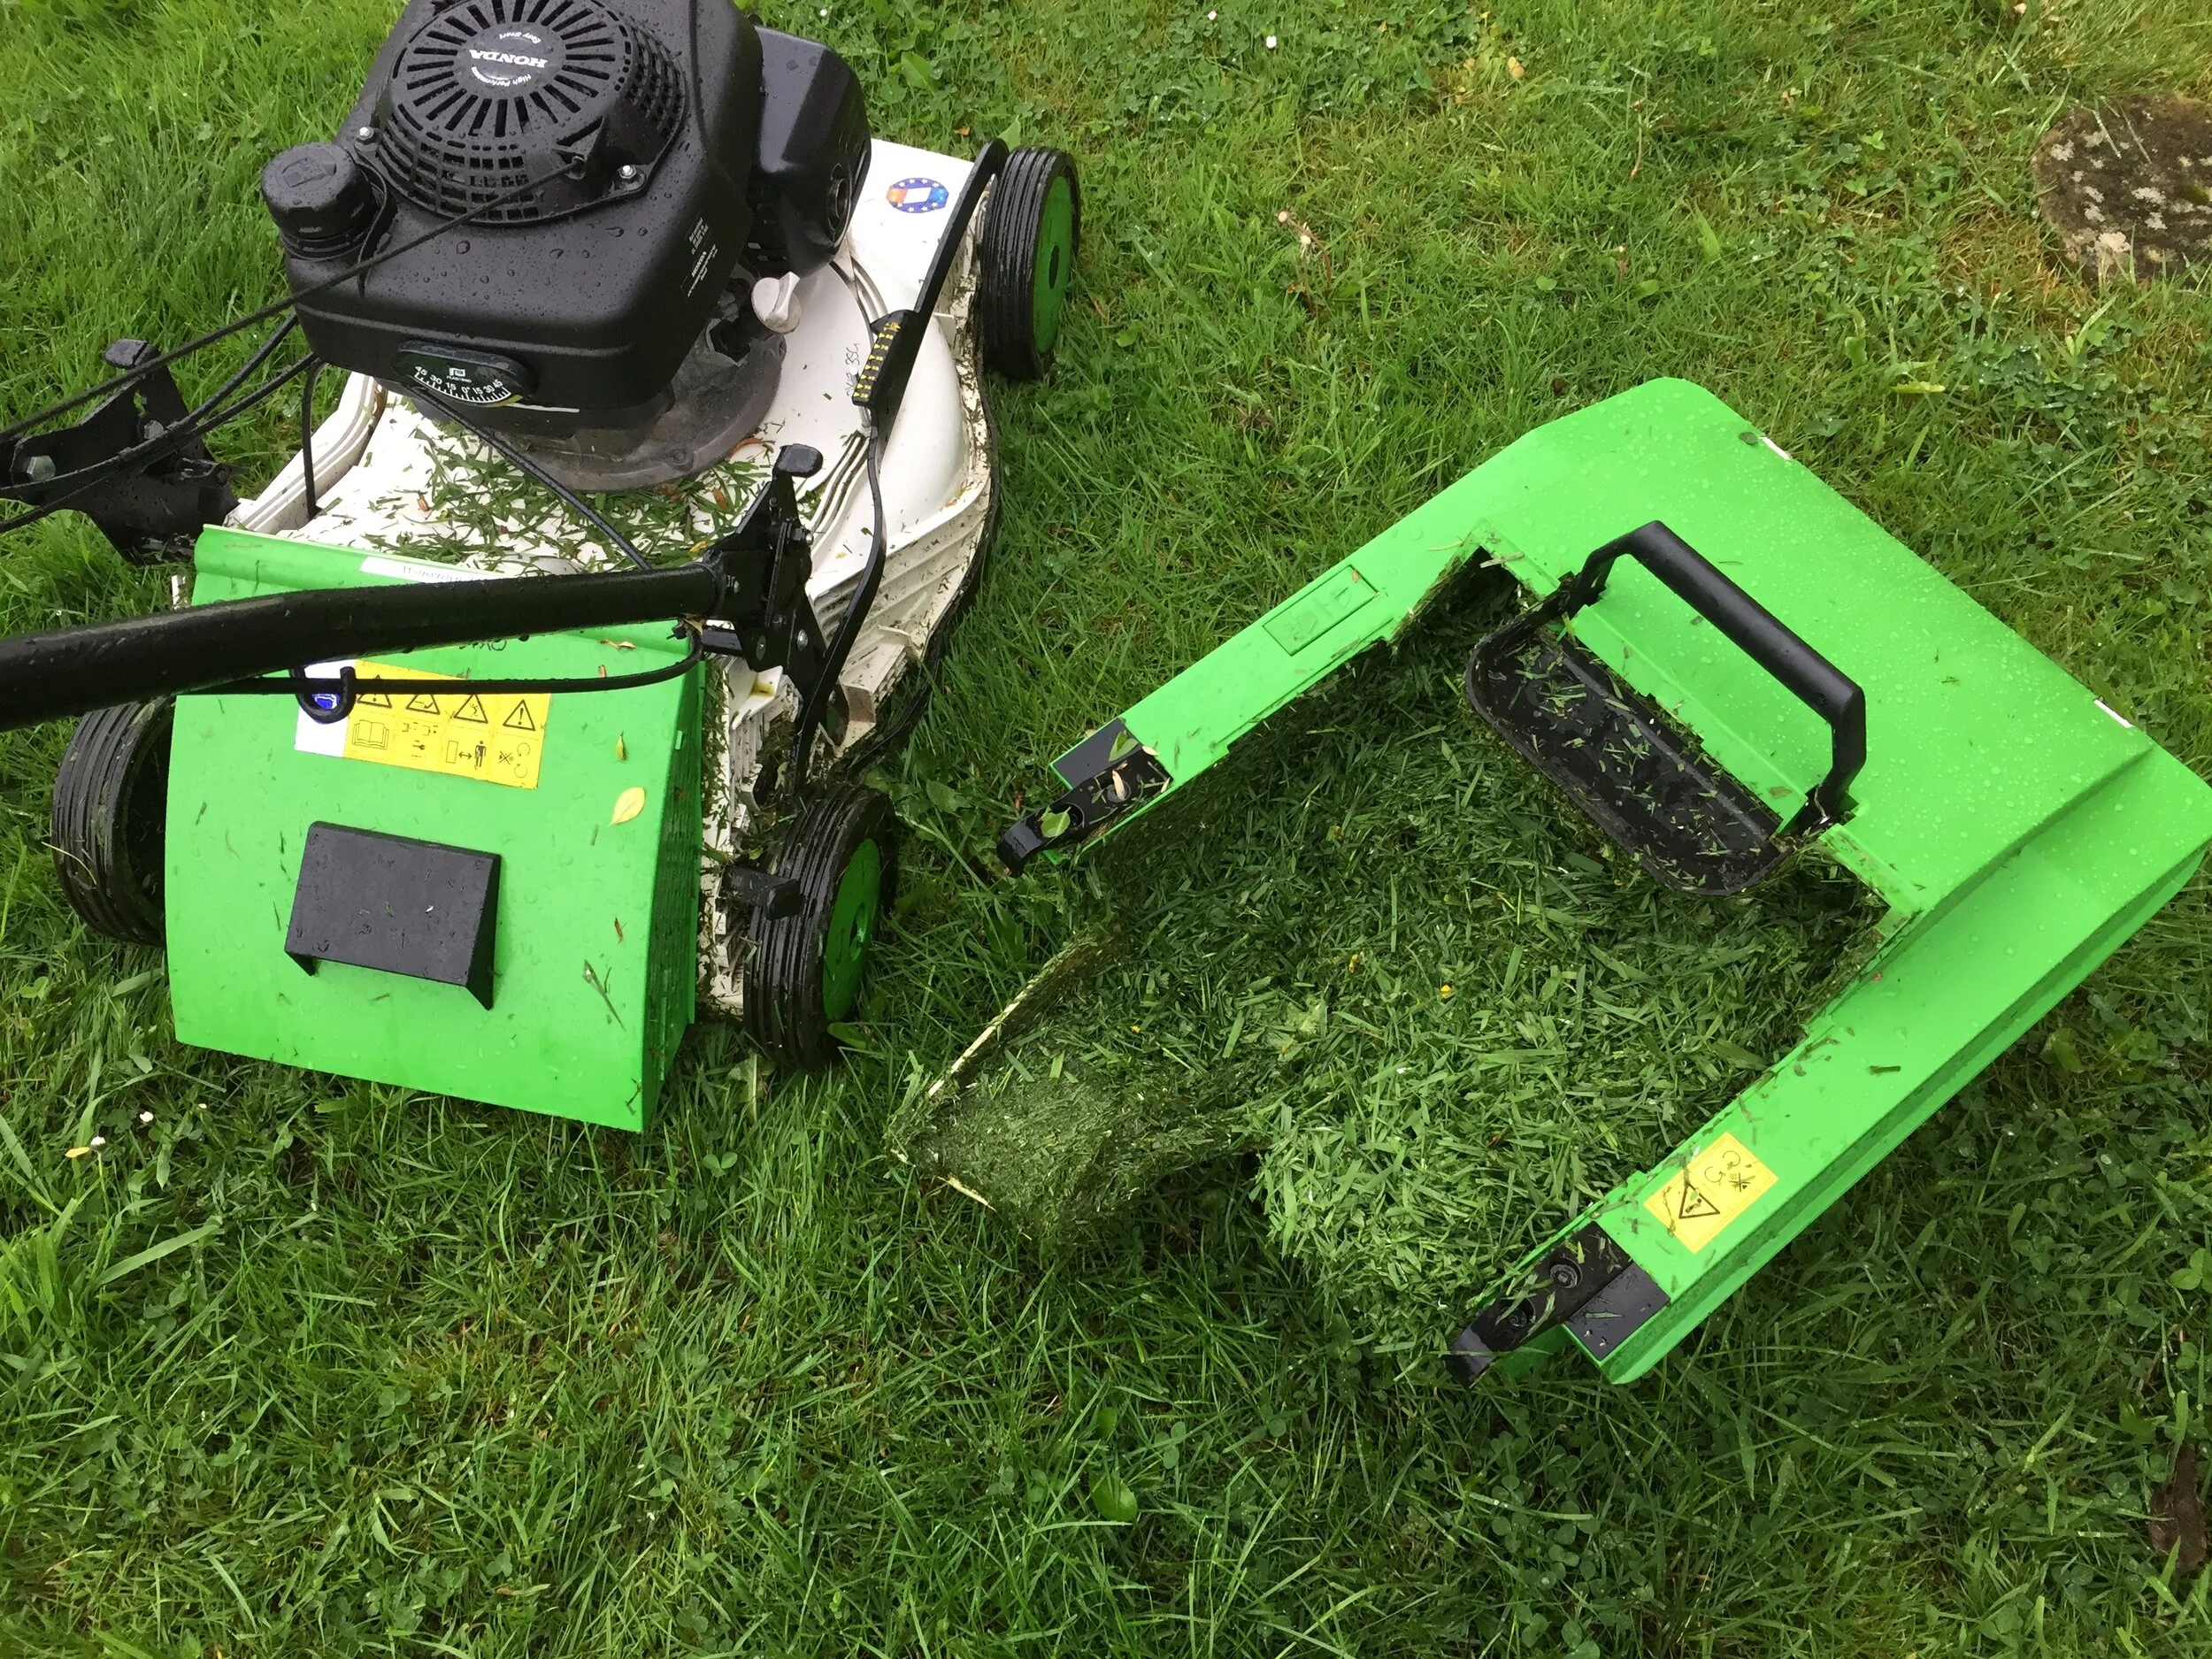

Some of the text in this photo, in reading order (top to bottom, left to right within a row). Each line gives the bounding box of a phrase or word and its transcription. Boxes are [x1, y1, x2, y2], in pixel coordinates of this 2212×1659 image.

[469, 49, 548, 68] HONDA
[512, 73, 532, 85] High
[414, 365, 427, 376] 45
[430, 374, 443, 385] 30
[445, 381, 457, 391] 15
[483, 385, 495, 394] 30
[493, 379, 503, 389] 45
